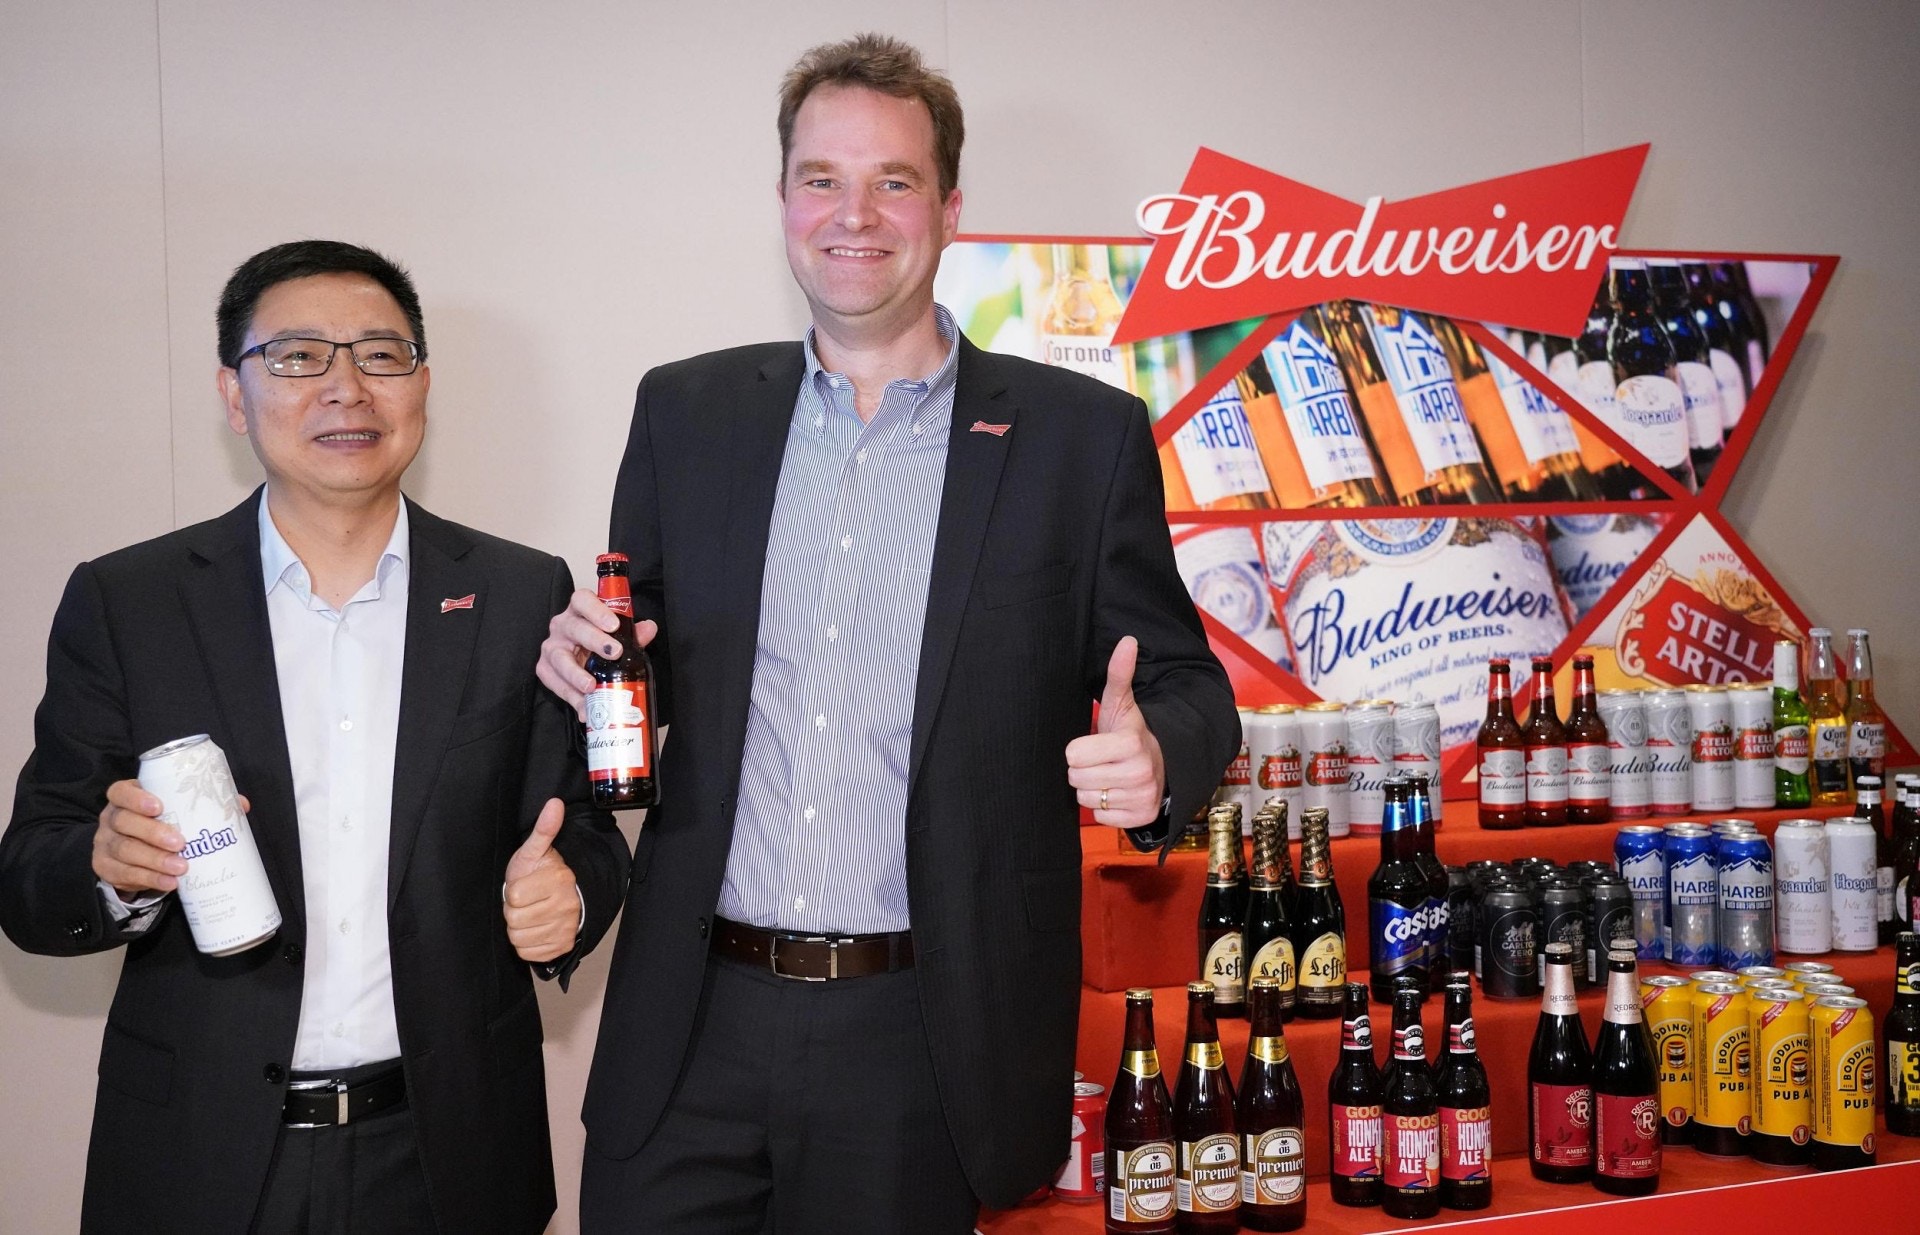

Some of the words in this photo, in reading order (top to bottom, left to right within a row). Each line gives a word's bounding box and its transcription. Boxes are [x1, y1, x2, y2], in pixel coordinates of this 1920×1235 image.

[1136, 190, 1618, 290] Budweiser
[1294, 572, 1555, 686] Budweiser
[1370, 643, 1412, 670] KING
[1418, 633, 1443, 651] OF
[1719, 1082, 1745, 1092] PUB
[1773, 1090, 1800, 1100] PUB
[1844, 1099, 1869, 1109] PUB
[1215, 1152, 1227, 1162] OB
[1278, 1145, 1291, 1155] OB
[1349, 1148, 1372, 1162] ALE
[1566, 1147, 1587, 1155] AMBER
[1459, 1150, 1481, 1166] ALE
[1150, 1161, 1162, 1171] OB
[1258, 1158, 1304, 1178] premier
[1399, 1158, 1422, 1174] ALE
[1194, 1165, 1241, 1185] premier
[1128, 1173, 1176, 1194] premier
